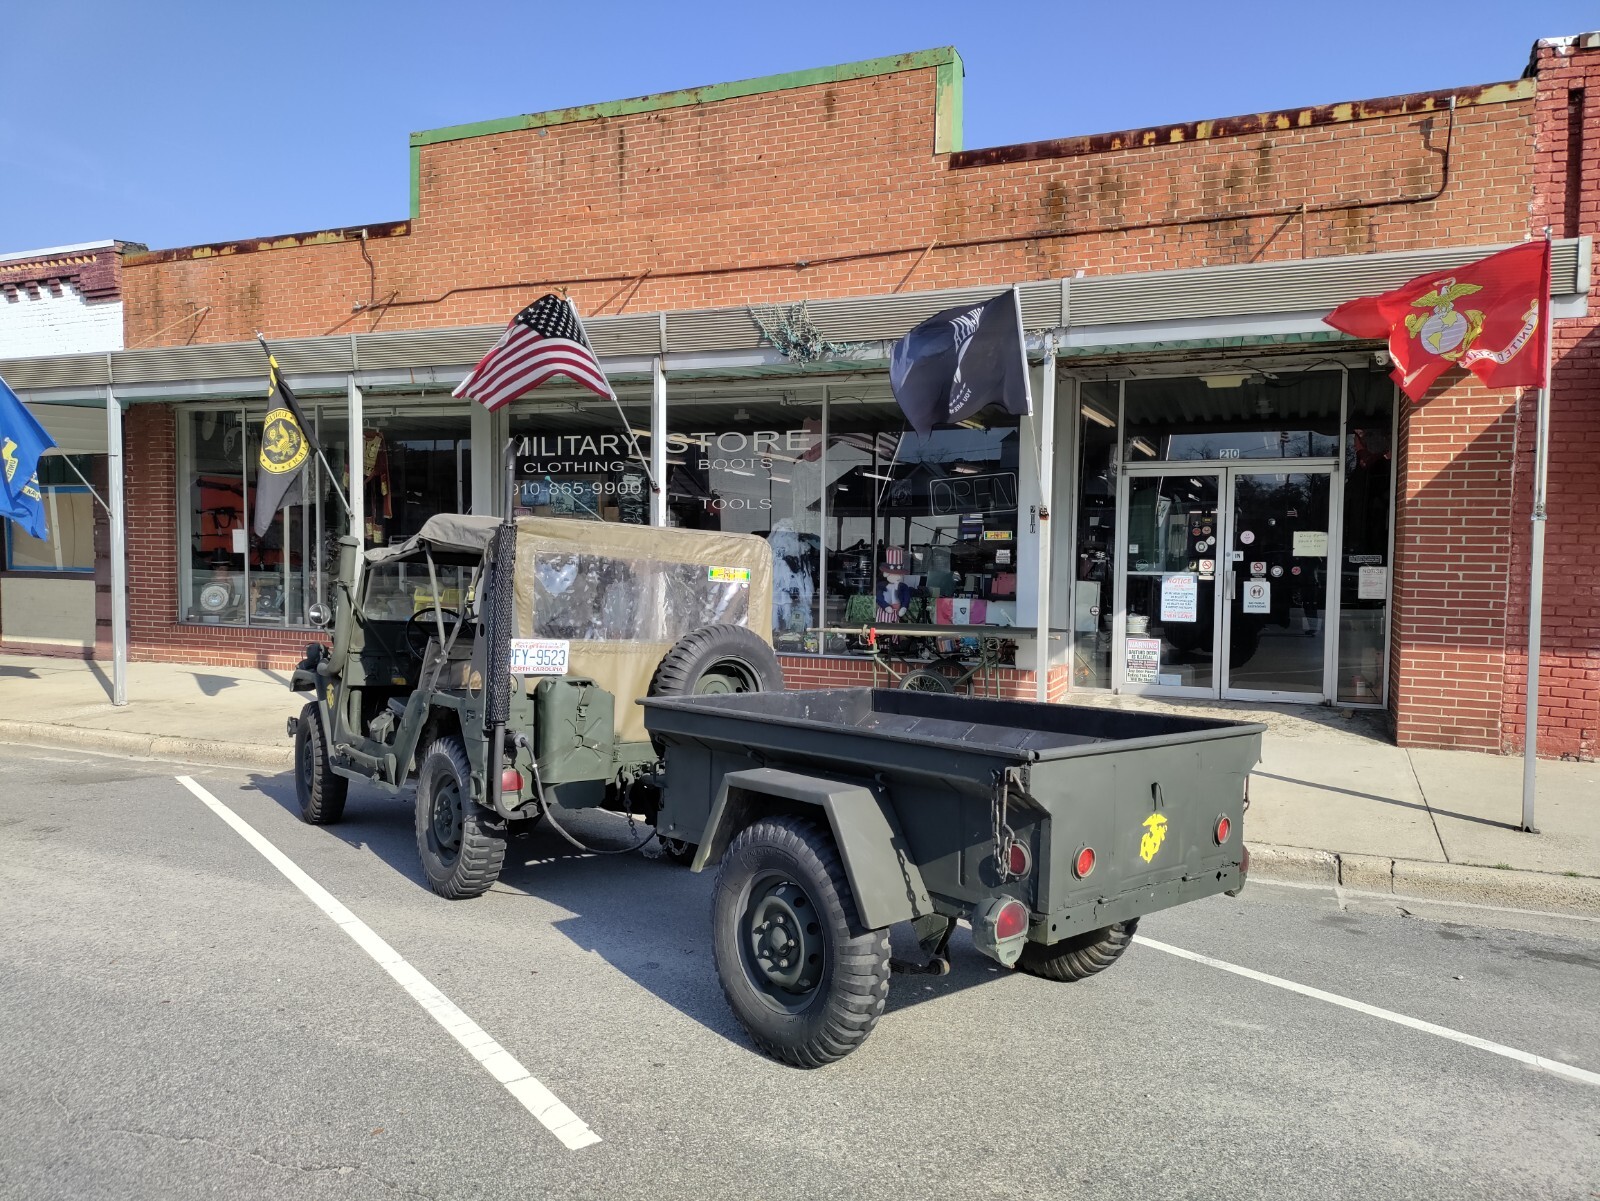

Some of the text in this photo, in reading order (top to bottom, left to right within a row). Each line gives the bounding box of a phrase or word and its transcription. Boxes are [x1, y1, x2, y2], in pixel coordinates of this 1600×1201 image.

[504, 430, 812, 456] MILITARY STORE
[1220, 450, 1239, 458] 210
[524, 458, 774, 473] CLOTHING BOOTS
[513, 482, 641, 495] 910-865-9900
[934, 476, 1014, 512] OPEN
[699, 498, 772, 510] TOOLS
